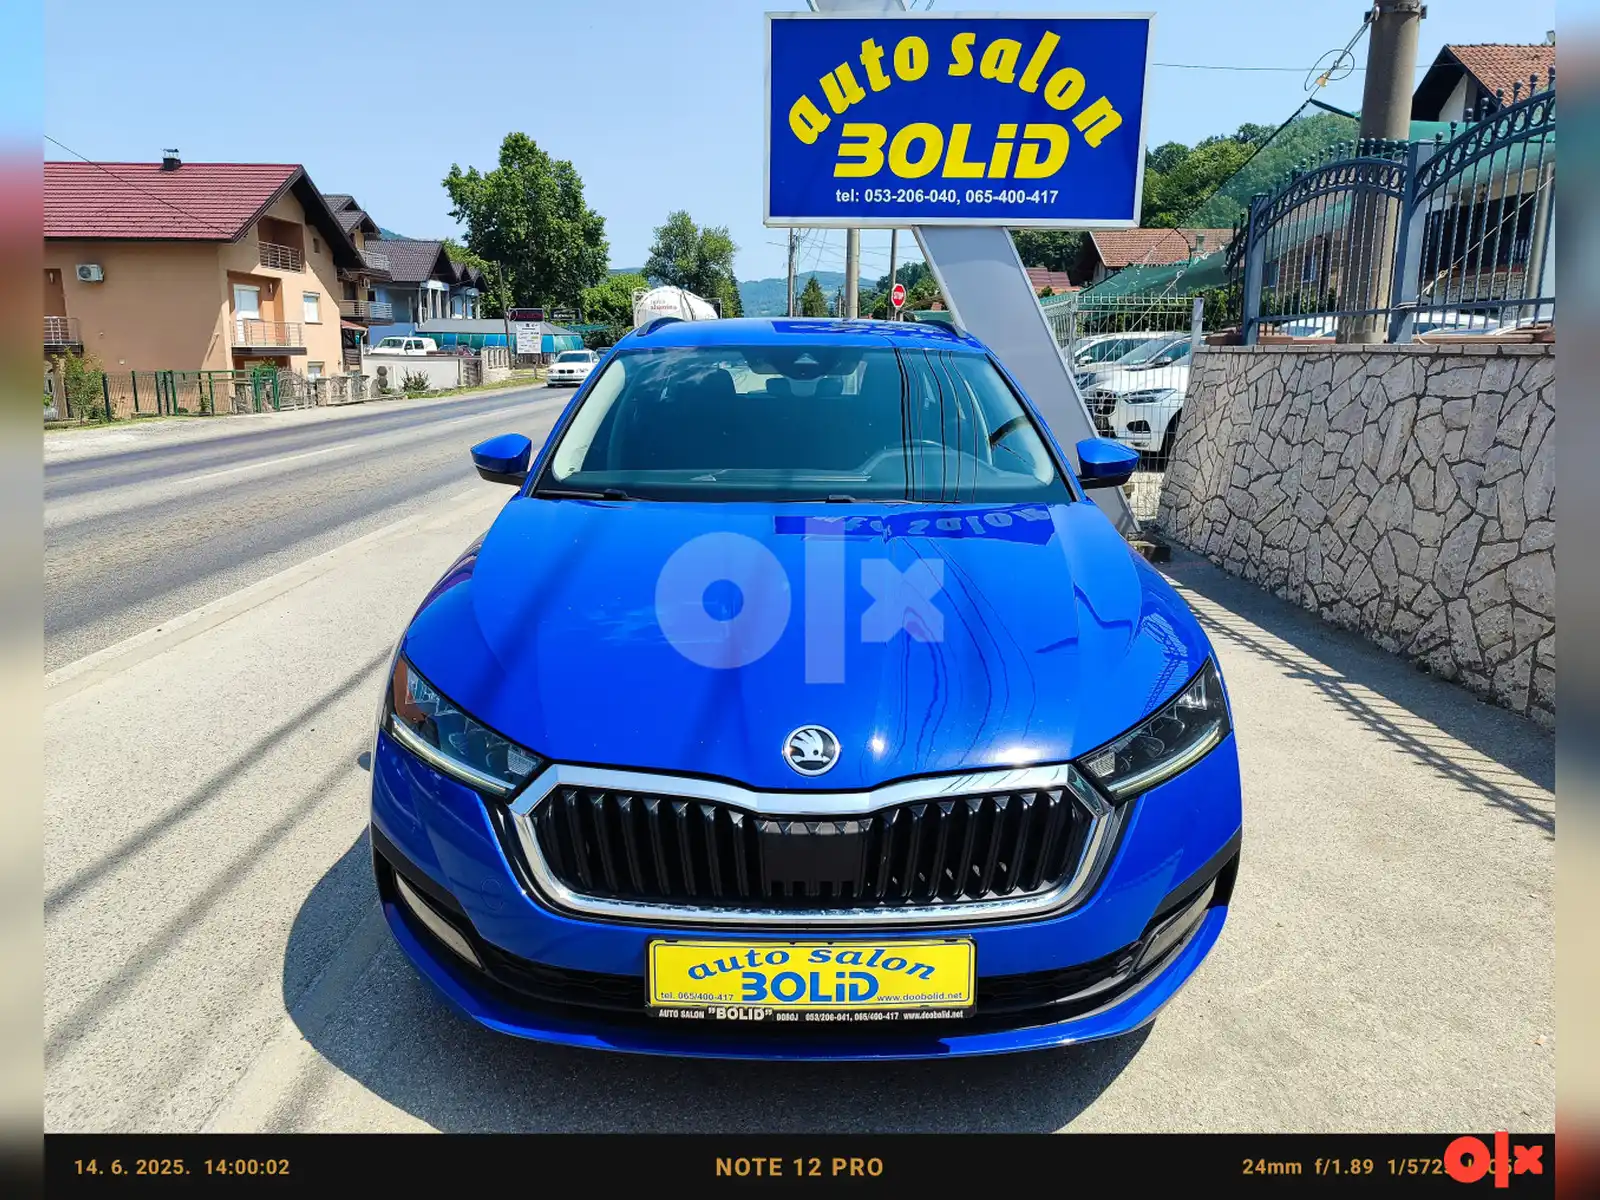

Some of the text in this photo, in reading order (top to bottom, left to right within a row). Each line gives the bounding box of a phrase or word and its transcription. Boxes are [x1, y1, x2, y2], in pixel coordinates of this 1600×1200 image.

[788, 31, 1123, 149] auto salon
[836, 188, 1059, 206] tel: 053-206-040, 065-400-417
[688, 948, 936, 981] auto salon
[877, 991, 963, 1001] www.doobolid.net
[659, 1008, 679, 1018] AUTO
[680, 1010, 705, 1019] SALON
